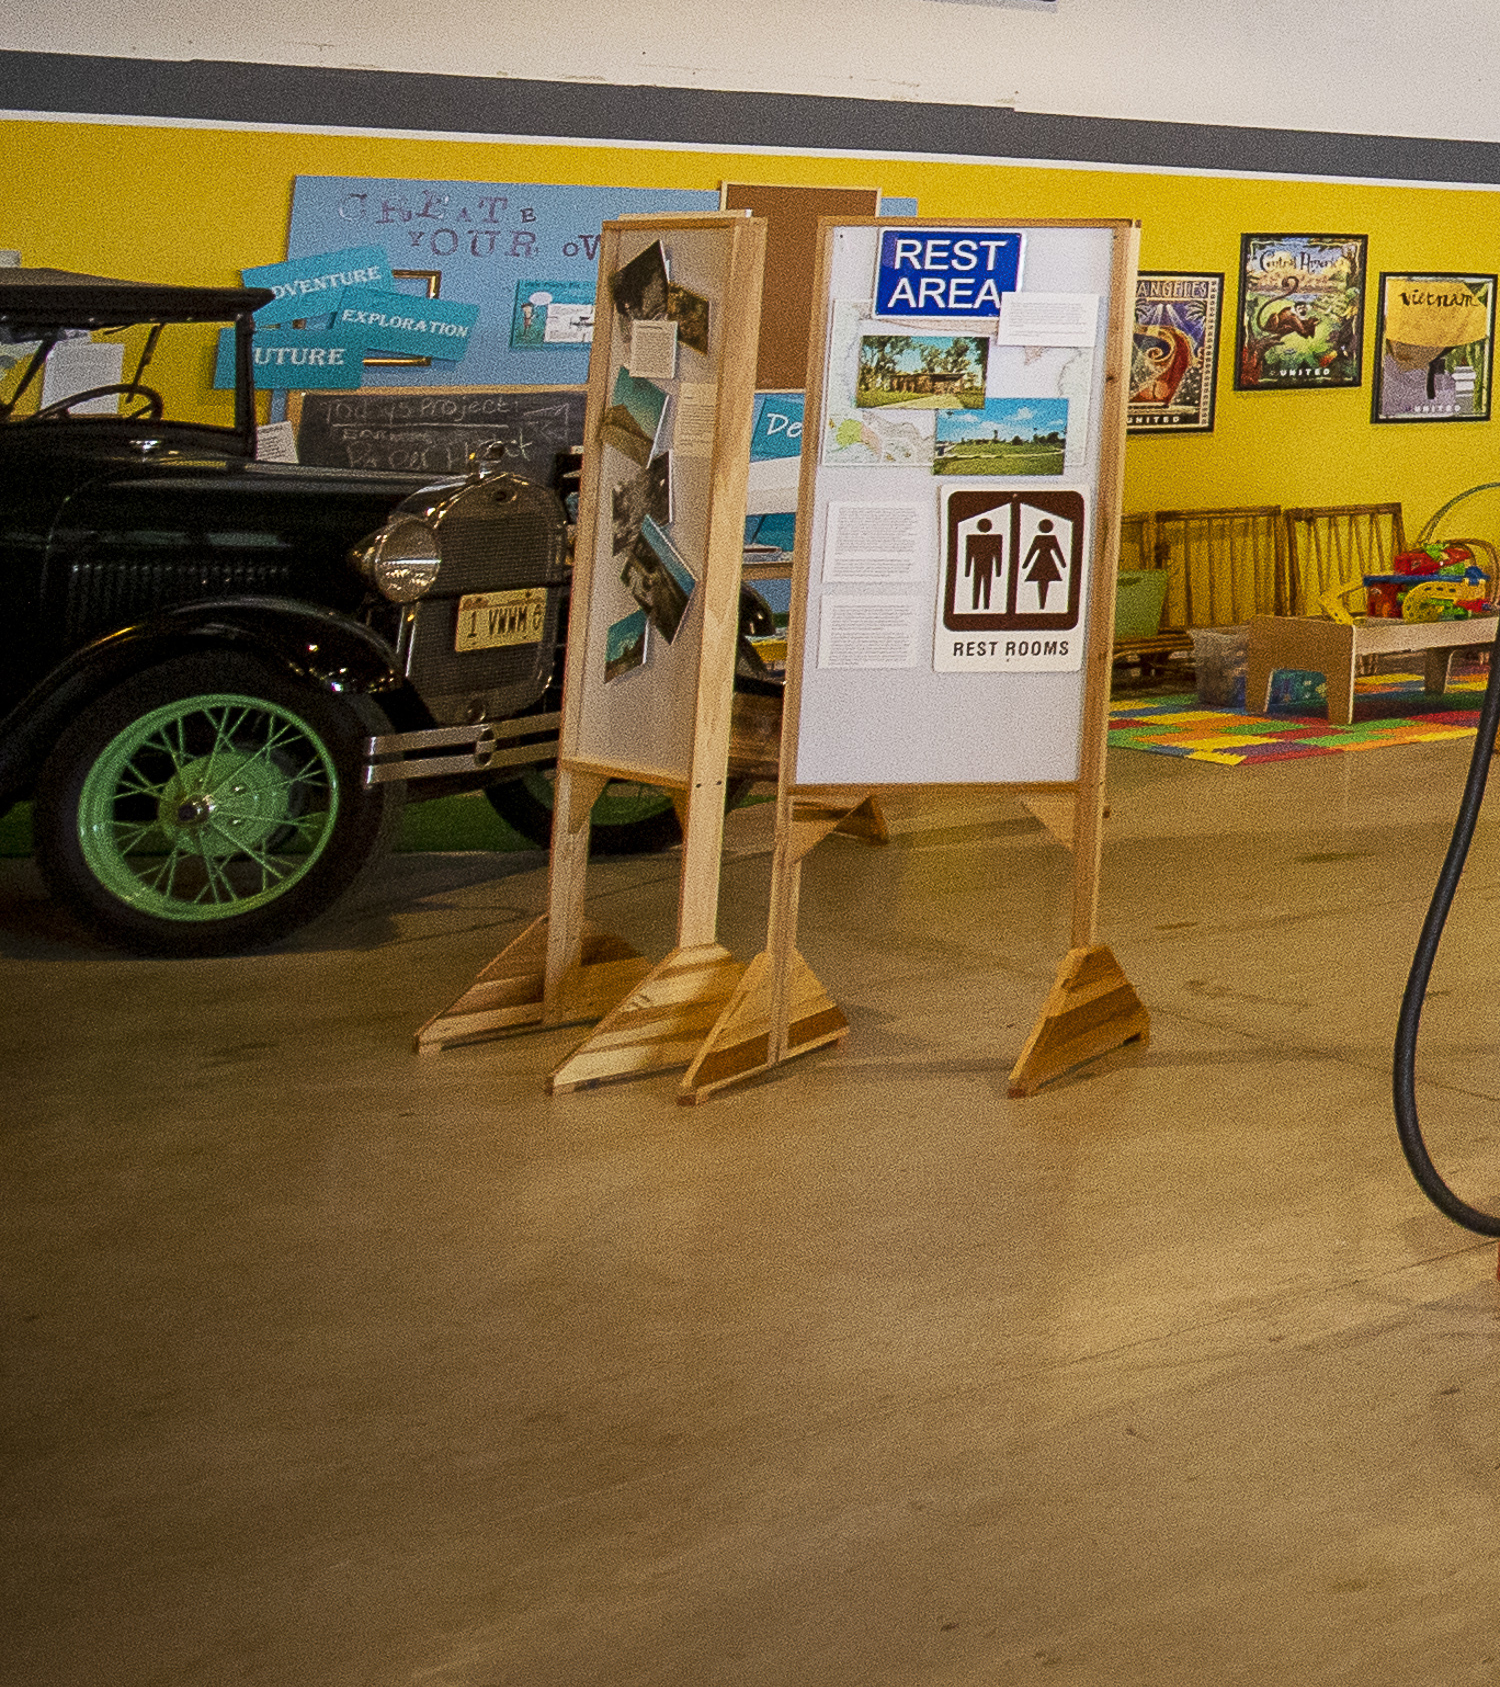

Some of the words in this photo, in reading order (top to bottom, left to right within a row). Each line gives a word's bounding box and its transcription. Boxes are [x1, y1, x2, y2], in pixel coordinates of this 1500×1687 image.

[337, 190, 537, 224] CREATE
[408, 228, 538, 258] YOUR
[893, 239, 1008, 271] REST
[272, 266, 382, 300] DVENTURE
[887, 277, 1001, 309] AREA
[1136, 280, 1207, 298] ANGELES
[341, 309, 469, 338] EXPLORATION
[254, 346, 345, 366] UTURE
[1415, 404, 1462, 413] UNITED
[952, 641, 999, 657] REST
[1004, 640, 1070, 657] ROOMS
